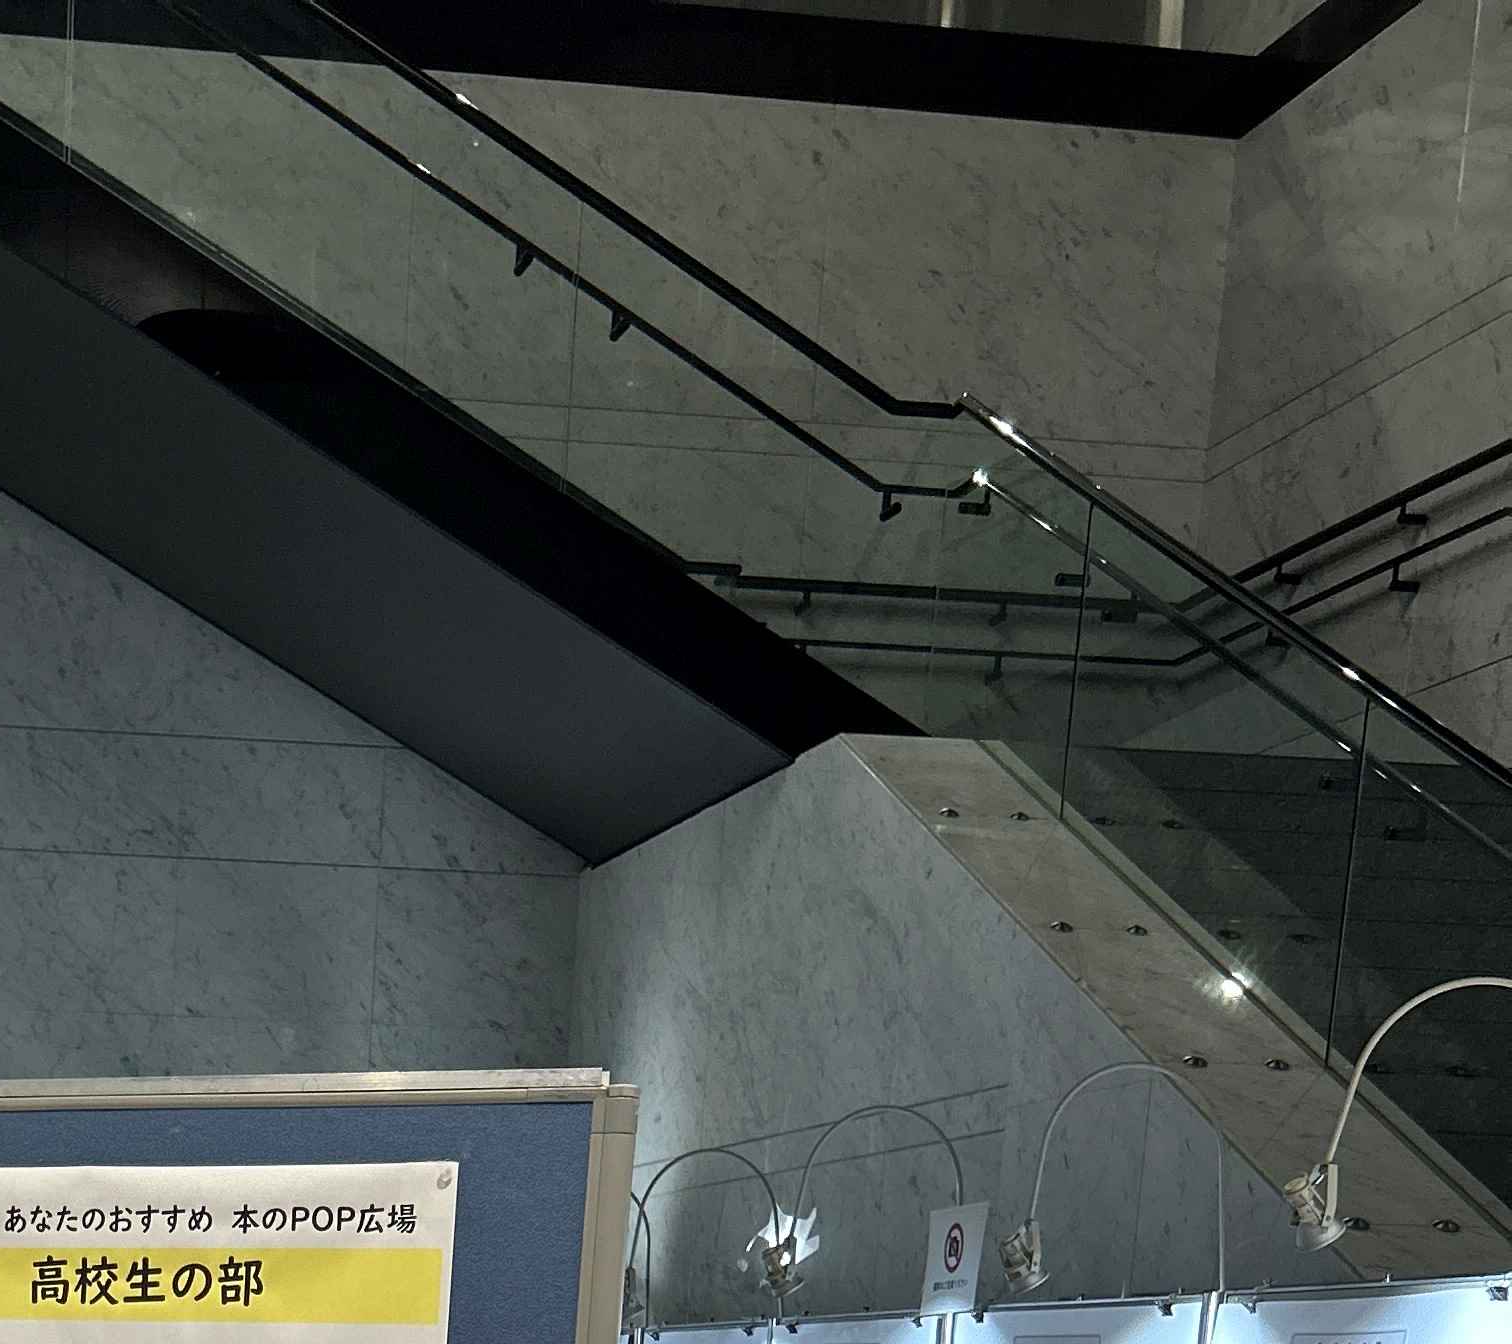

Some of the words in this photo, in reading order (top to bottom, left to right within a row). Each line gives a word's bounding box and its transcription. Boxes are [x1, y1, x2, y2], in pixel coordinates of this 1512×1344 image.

[3, 1204, 215, 1234] あなたのおすすめ
[231, 1203, 418, 1236] 本のPOP広場
[29, 1255, 265, 1307] 高校生の部
